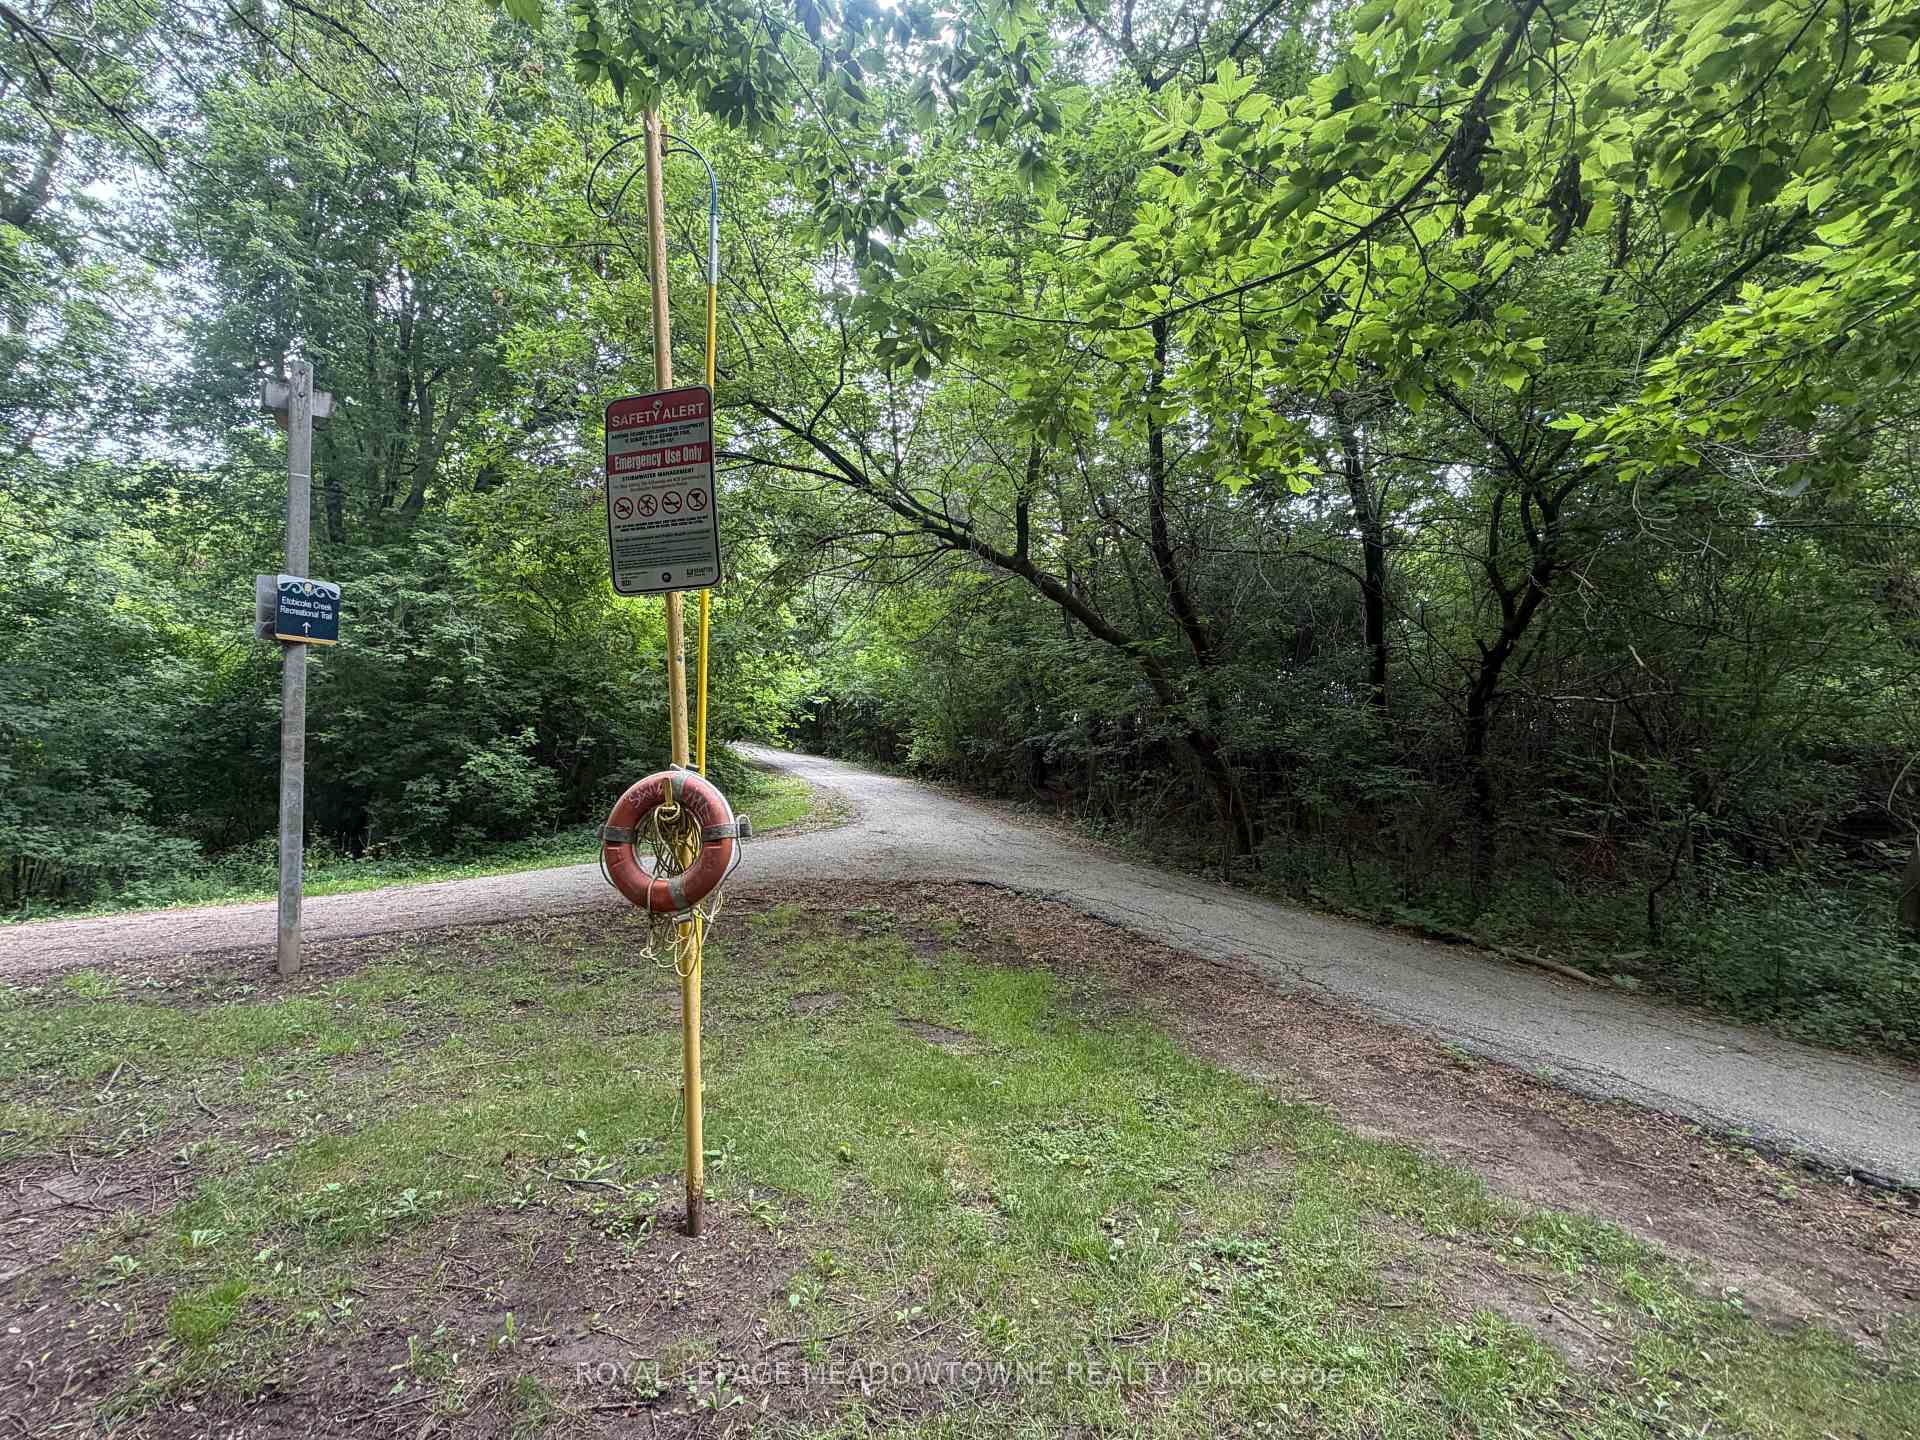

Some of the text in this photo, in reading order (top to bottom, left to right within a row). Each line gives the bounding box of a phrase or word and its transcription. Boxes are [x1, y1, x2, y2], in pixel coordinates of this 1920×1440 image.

[612, 402, 705, 427] SAFETY ALERT
[614, 445, 703, 471] Emergency Use Only
[280, 605, 333, 620] Recreational Trail
[281, 596, 332, 611] Etobicoke Creek
